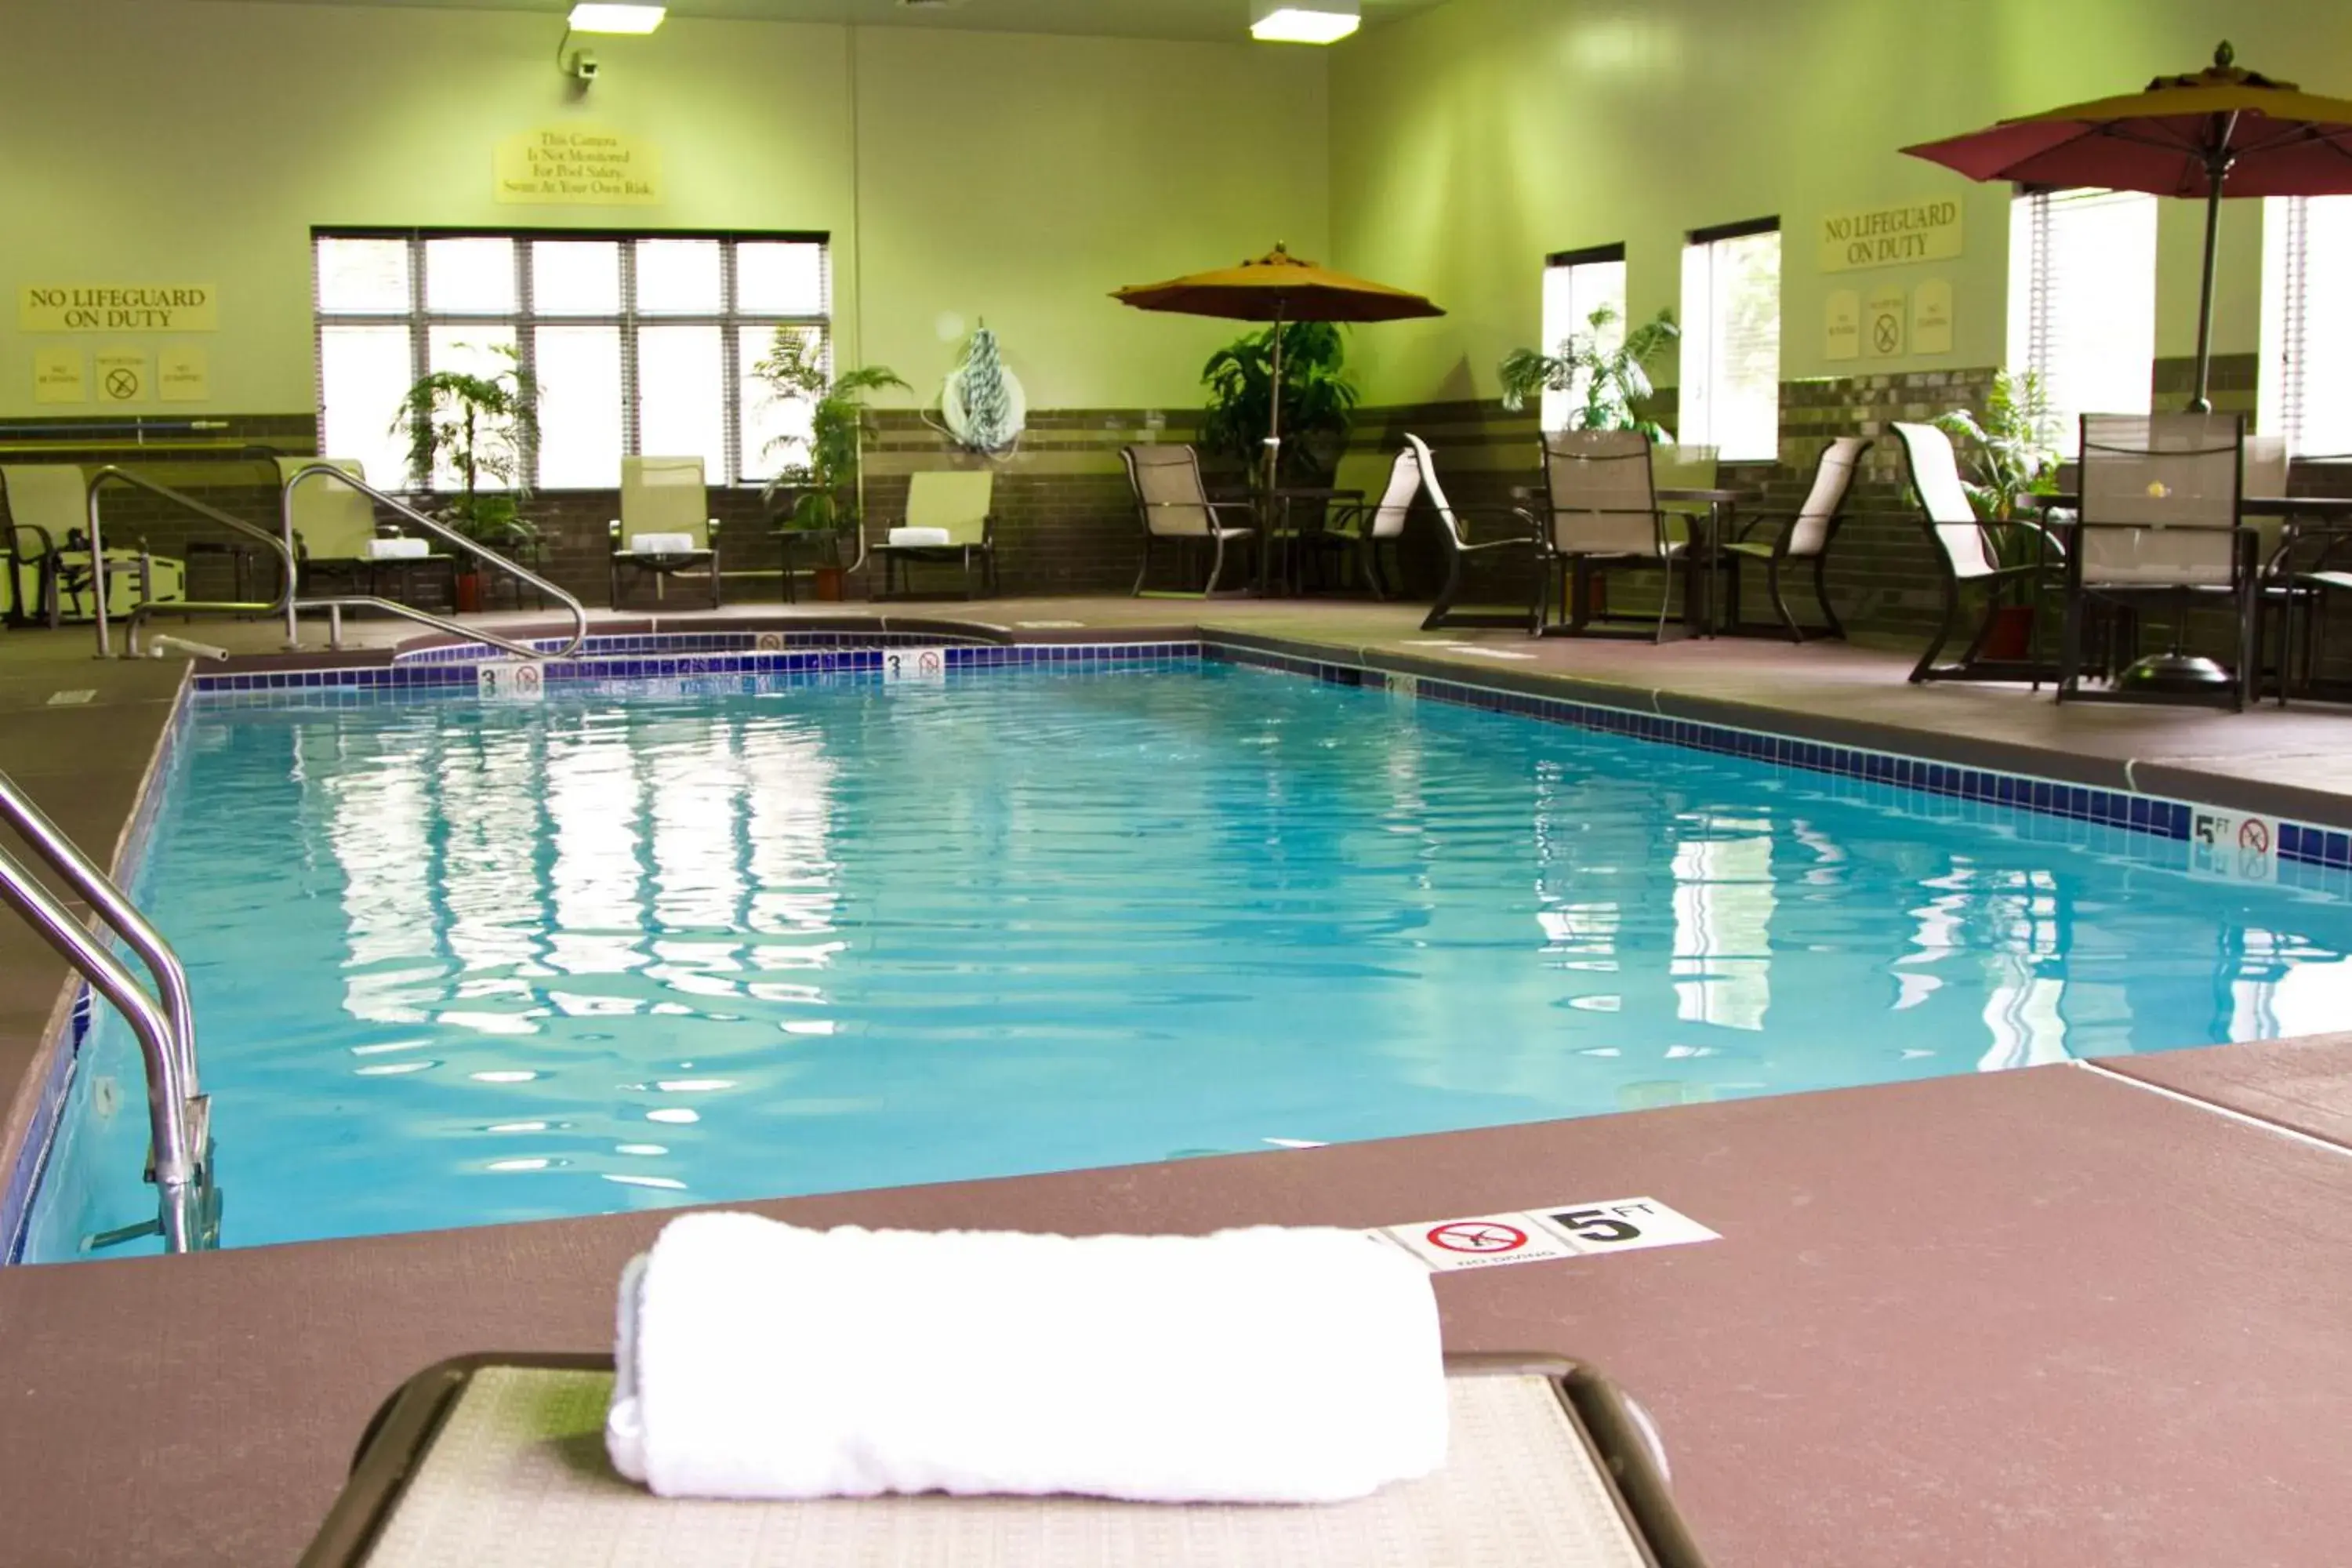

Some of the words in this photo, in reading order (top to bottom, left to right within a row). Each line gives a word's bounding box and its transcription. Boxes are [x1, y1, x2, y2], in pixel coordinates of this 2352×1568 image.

[1826, 217, 1852, 242] NO
[1853, 201, 1956, 238] LIFEGUARD
[1847, 241, 1873, 264] ON
[1878, 232, 1929, 261] DUTY
[31, 289, 67, 308] NO
[73, 289, 206, 307] LIFEGUARD
[64, 310, 99, 328] ON
[107, 309, 172, 328] DUTY
[2197, 815, 2214, 844] 5
[2216, 817, 2230, 835] FT
[1549, 1209, 1642, 1242] 5
[1611, 1203, 1654, 1218] FT
